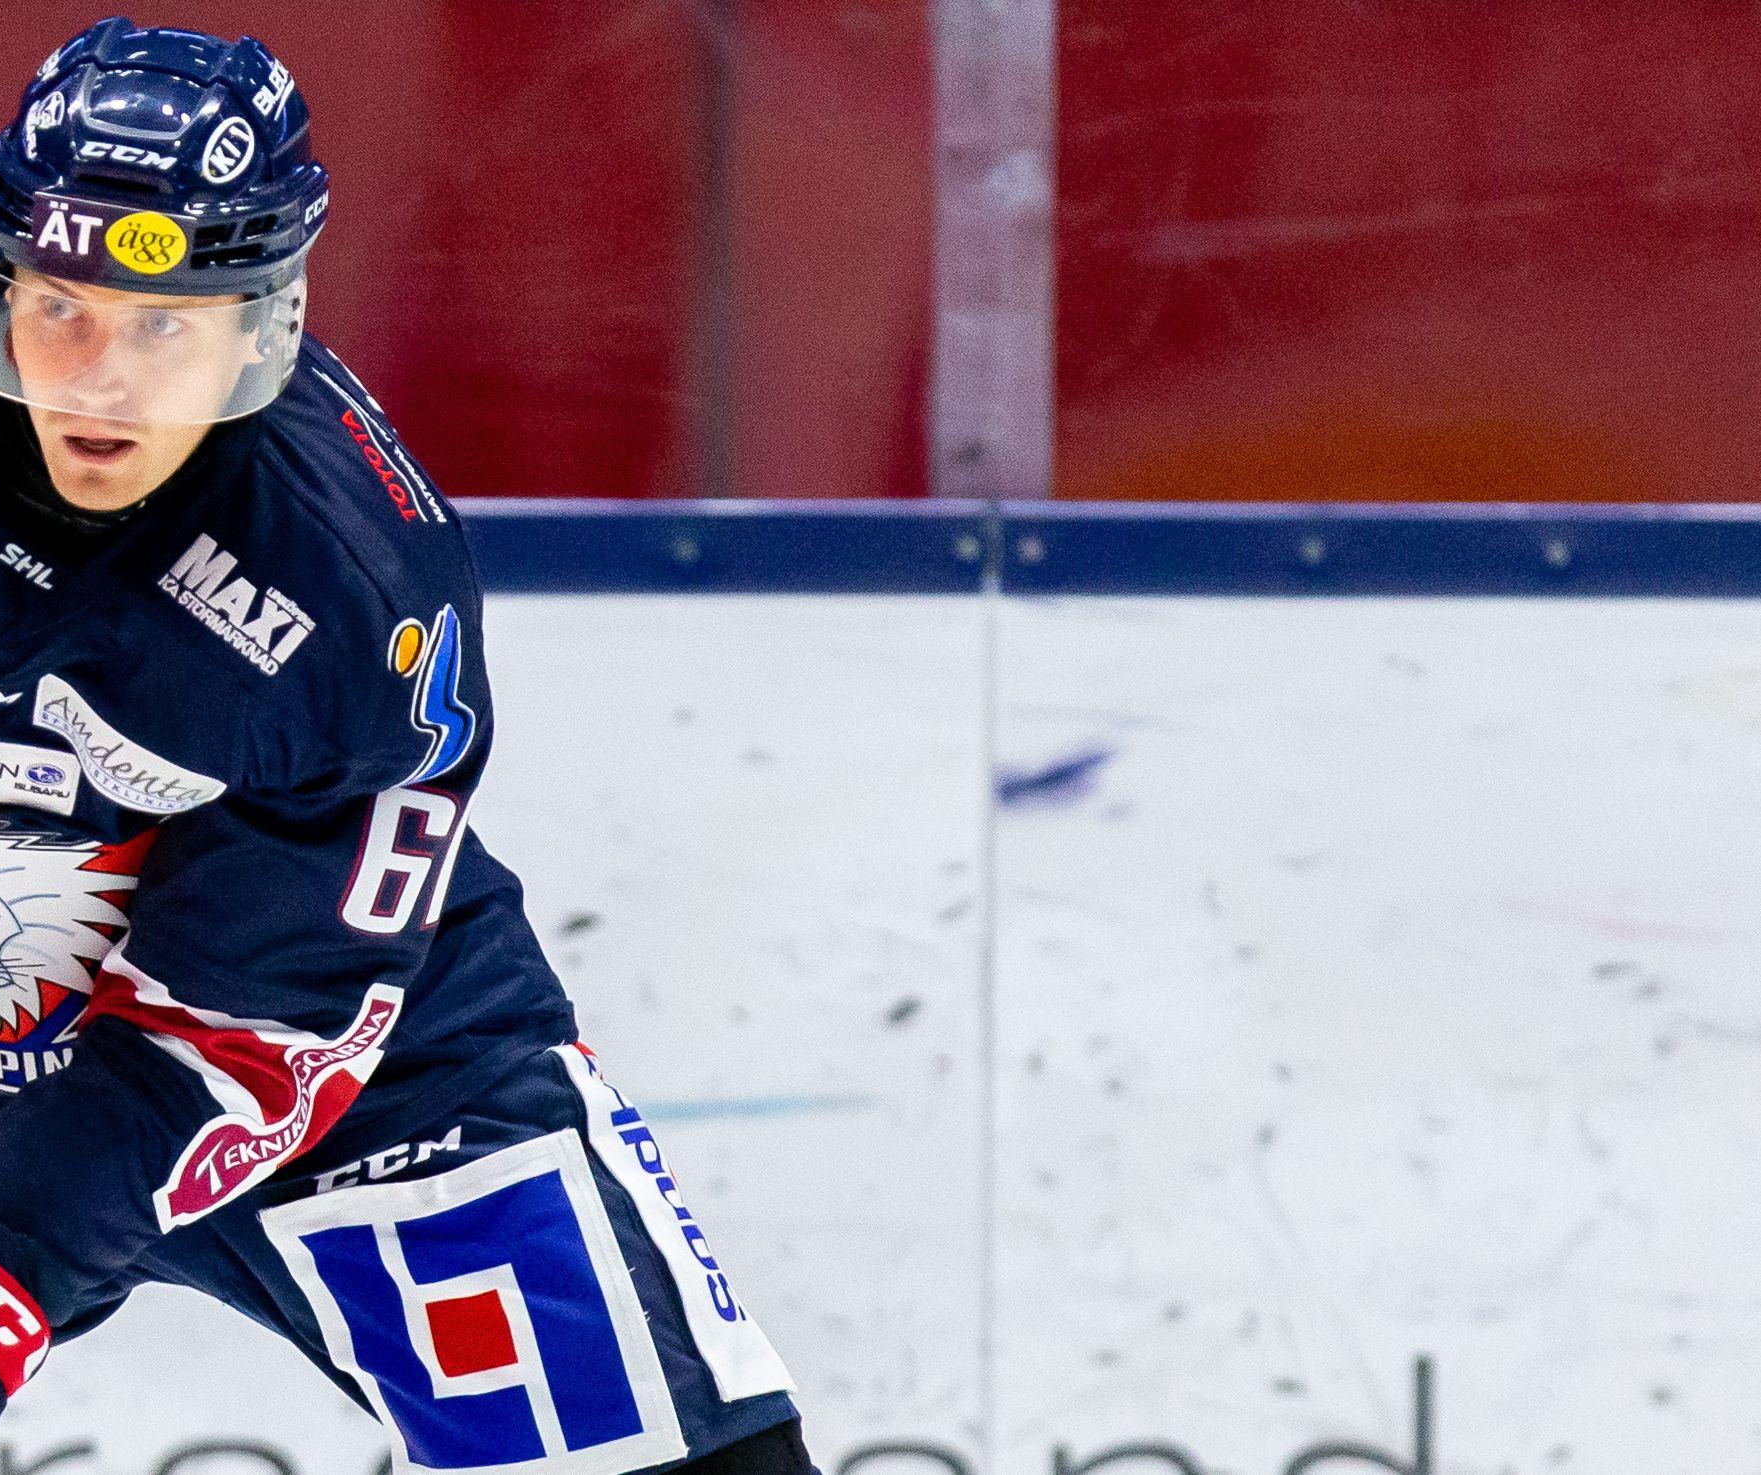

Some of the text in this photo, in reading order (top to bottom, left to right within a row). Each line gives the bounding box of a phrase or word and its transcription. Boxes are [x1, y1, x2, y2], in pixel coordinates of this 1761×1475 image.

[78, 140, 178, 171] CCM
[36, 200, 180, 266] ÄT ägg
[341, 408, 418, 523] TOYOTA
[169, 532, 309, 665] MAXI
[178, 590, 280, 677] STORMARKNAD
[13, 781, 71, 798] SUBARU
[339, 785, 472, 936] 61
[313, 1124, 462, 1195] CCM
